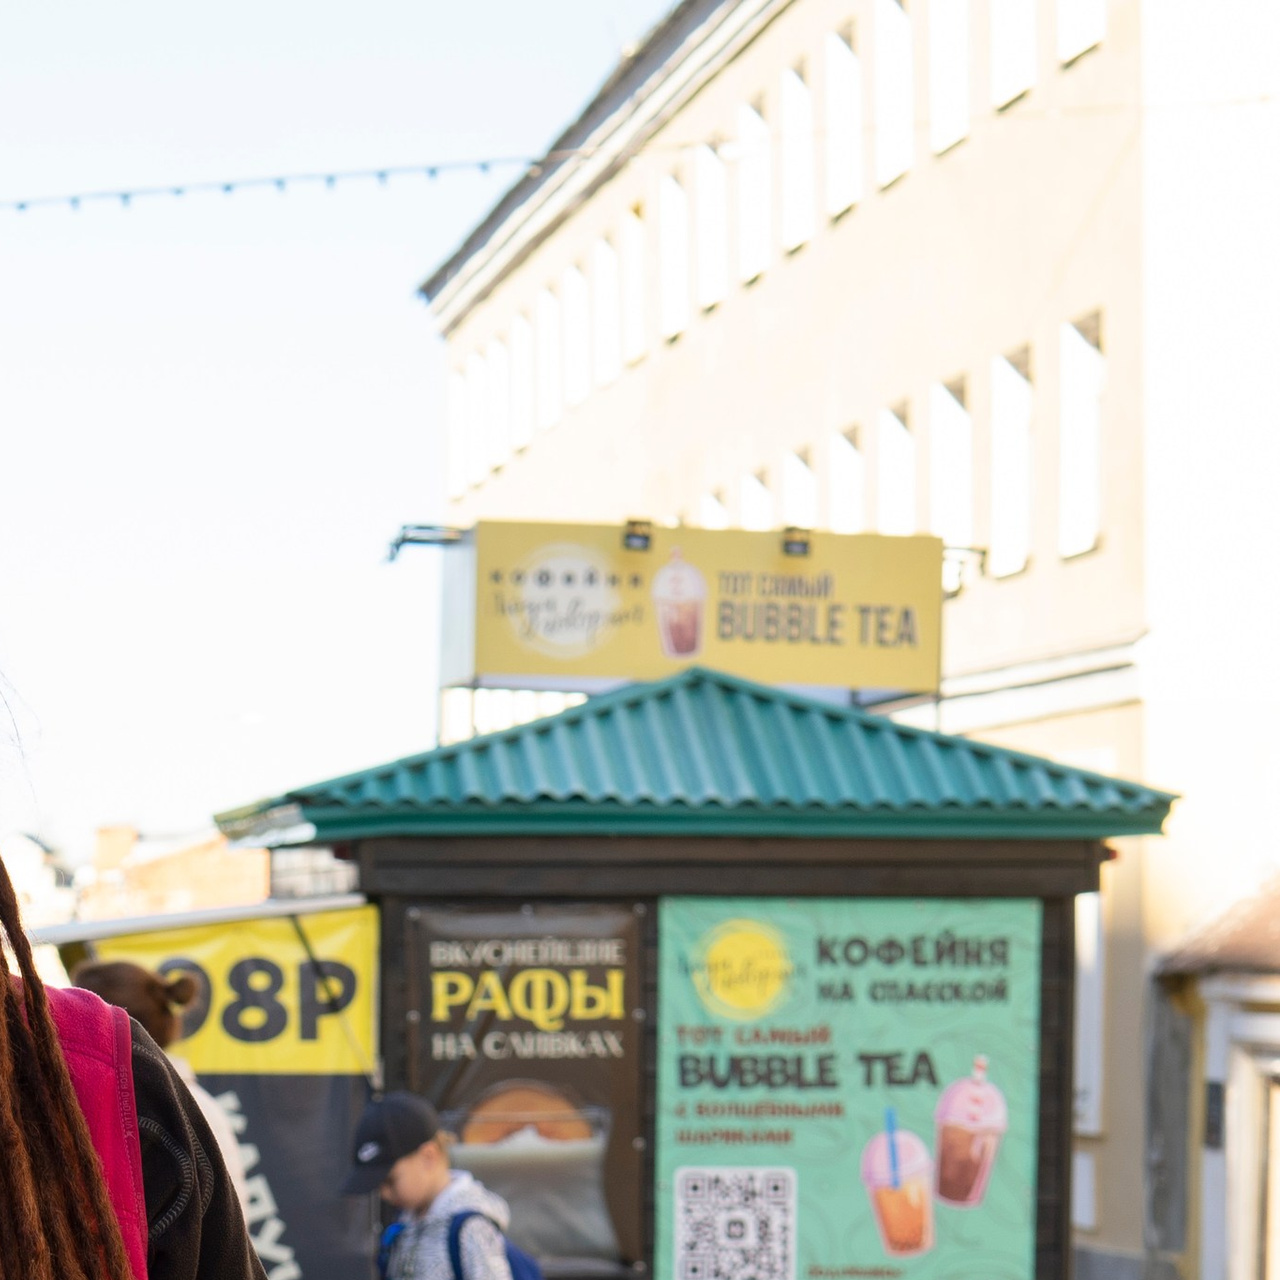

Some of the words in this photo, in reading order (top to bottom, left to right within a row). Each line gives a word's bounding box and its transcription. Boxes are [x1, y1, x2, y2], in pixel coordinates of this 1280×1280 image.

[718, 571, 751, 595] ТОТ
[758, 571, 834, 598] САМЫЙ
[717, 602, 847, 645] BUBBLE
[857, 606, 919, 649] TEA
[430, 936, 625, 966] ВКУСНЕЙШИЕ
[817, 930, 1010, 966] КОФЕЙНЯ
[431, 969, 625, 1032] РАФЫ
[818, 981, 854, 1001] НА
[869, 977, 1009, 1002] СПАССКОЙ
[431, 1032, 477, 1060] НА
[482, 1031, 624, 1060] СЛИВКАХ
[677, 1026, 722, 1045] ТОТ
[736, 1025, 831, 1045] САМЫЙ
[679, 1054, 838, 1087] BUBBLE
[858, 1050, 939, 1087] TEA
